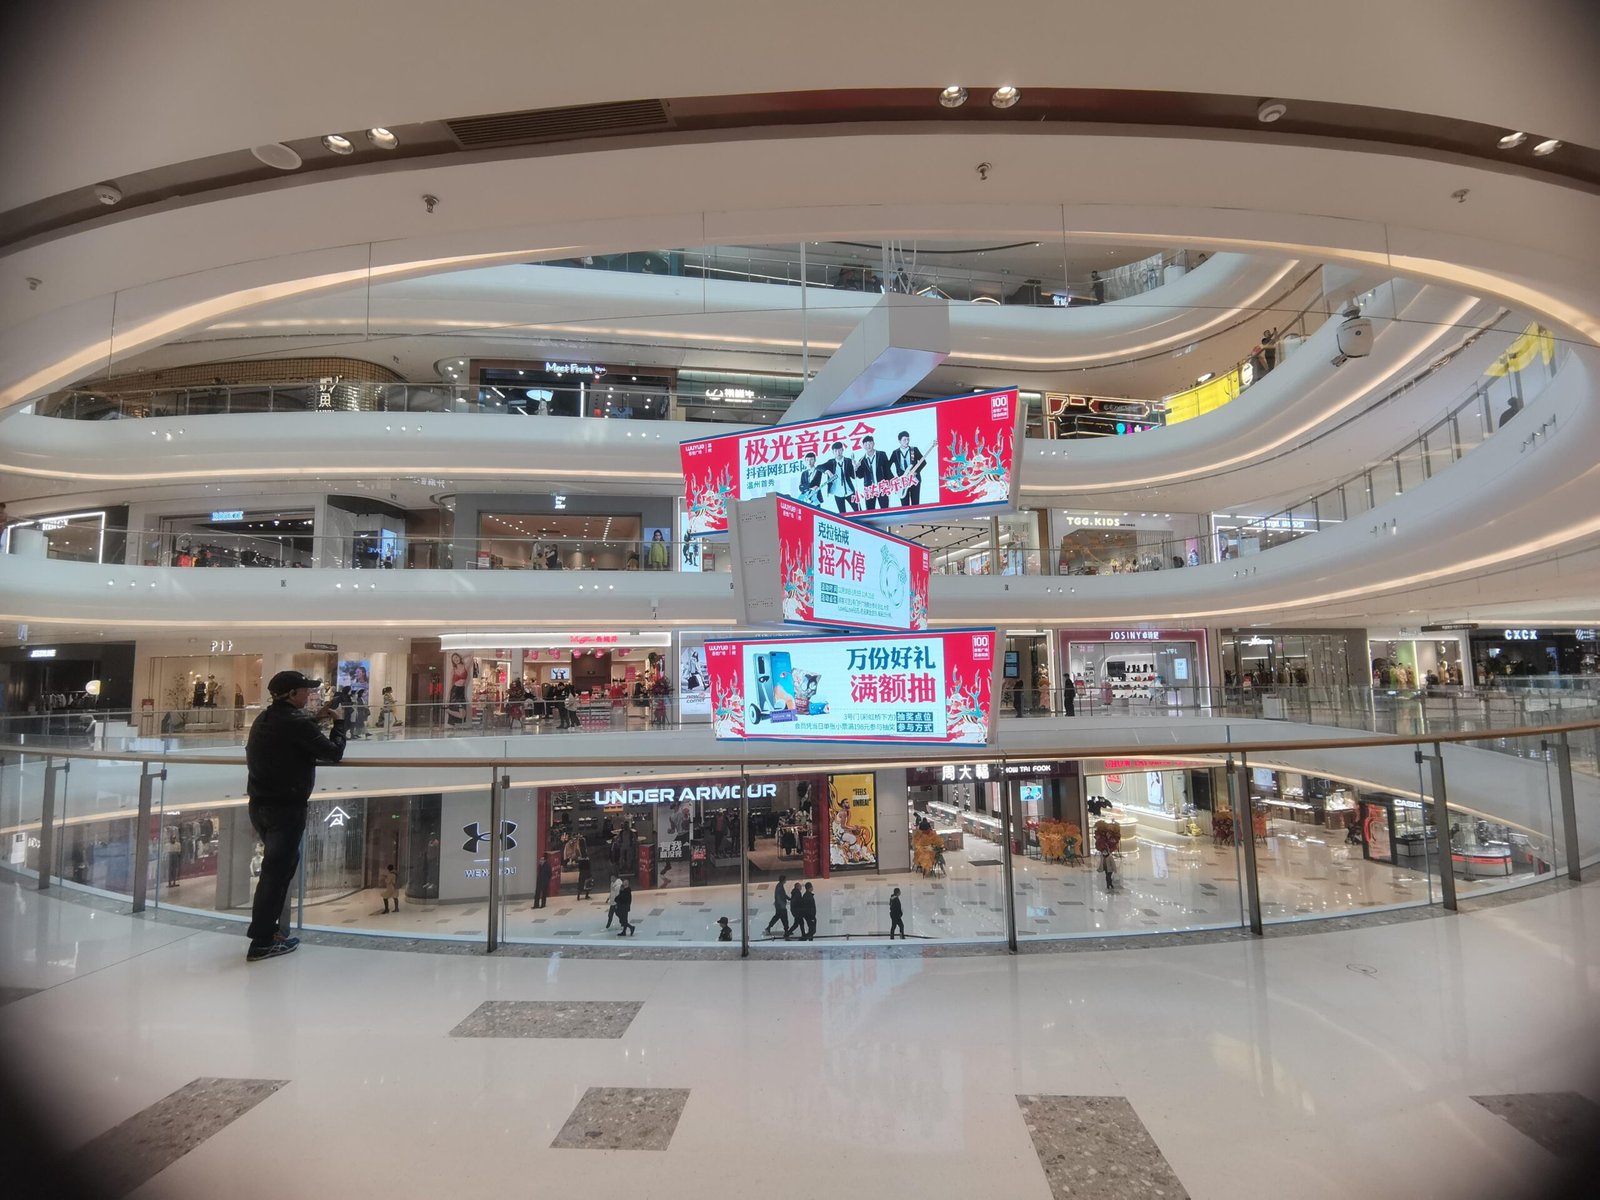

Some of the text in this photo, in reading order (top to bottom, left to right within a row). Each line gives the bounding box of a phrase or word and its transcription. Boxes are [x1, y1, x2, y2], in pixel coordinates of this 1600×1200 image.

[545, 361, 569, 373] Meet
[570, 363, 593, 374] Fresh
[993, 397, 1007, 407] 100
[745, 422, 876, 466] 极光音乐会
[818, 521, 849, 545] 克拉钻戒
[818, 540, 865, 582] 摇不停
[974, 637, 988, 647] 100
[1505, 630, 1537, 640] CXCX
[846, 646, 936, 670] 万份好礼
[850, 672, 936, 703] 满额抽
[897, 713, 932, 721] 抽奖点位
[897, 723, 932, 732] 参与方式
[942, 764, 989, 781] 周大福
[594, 788, 675, 805] UNDER
